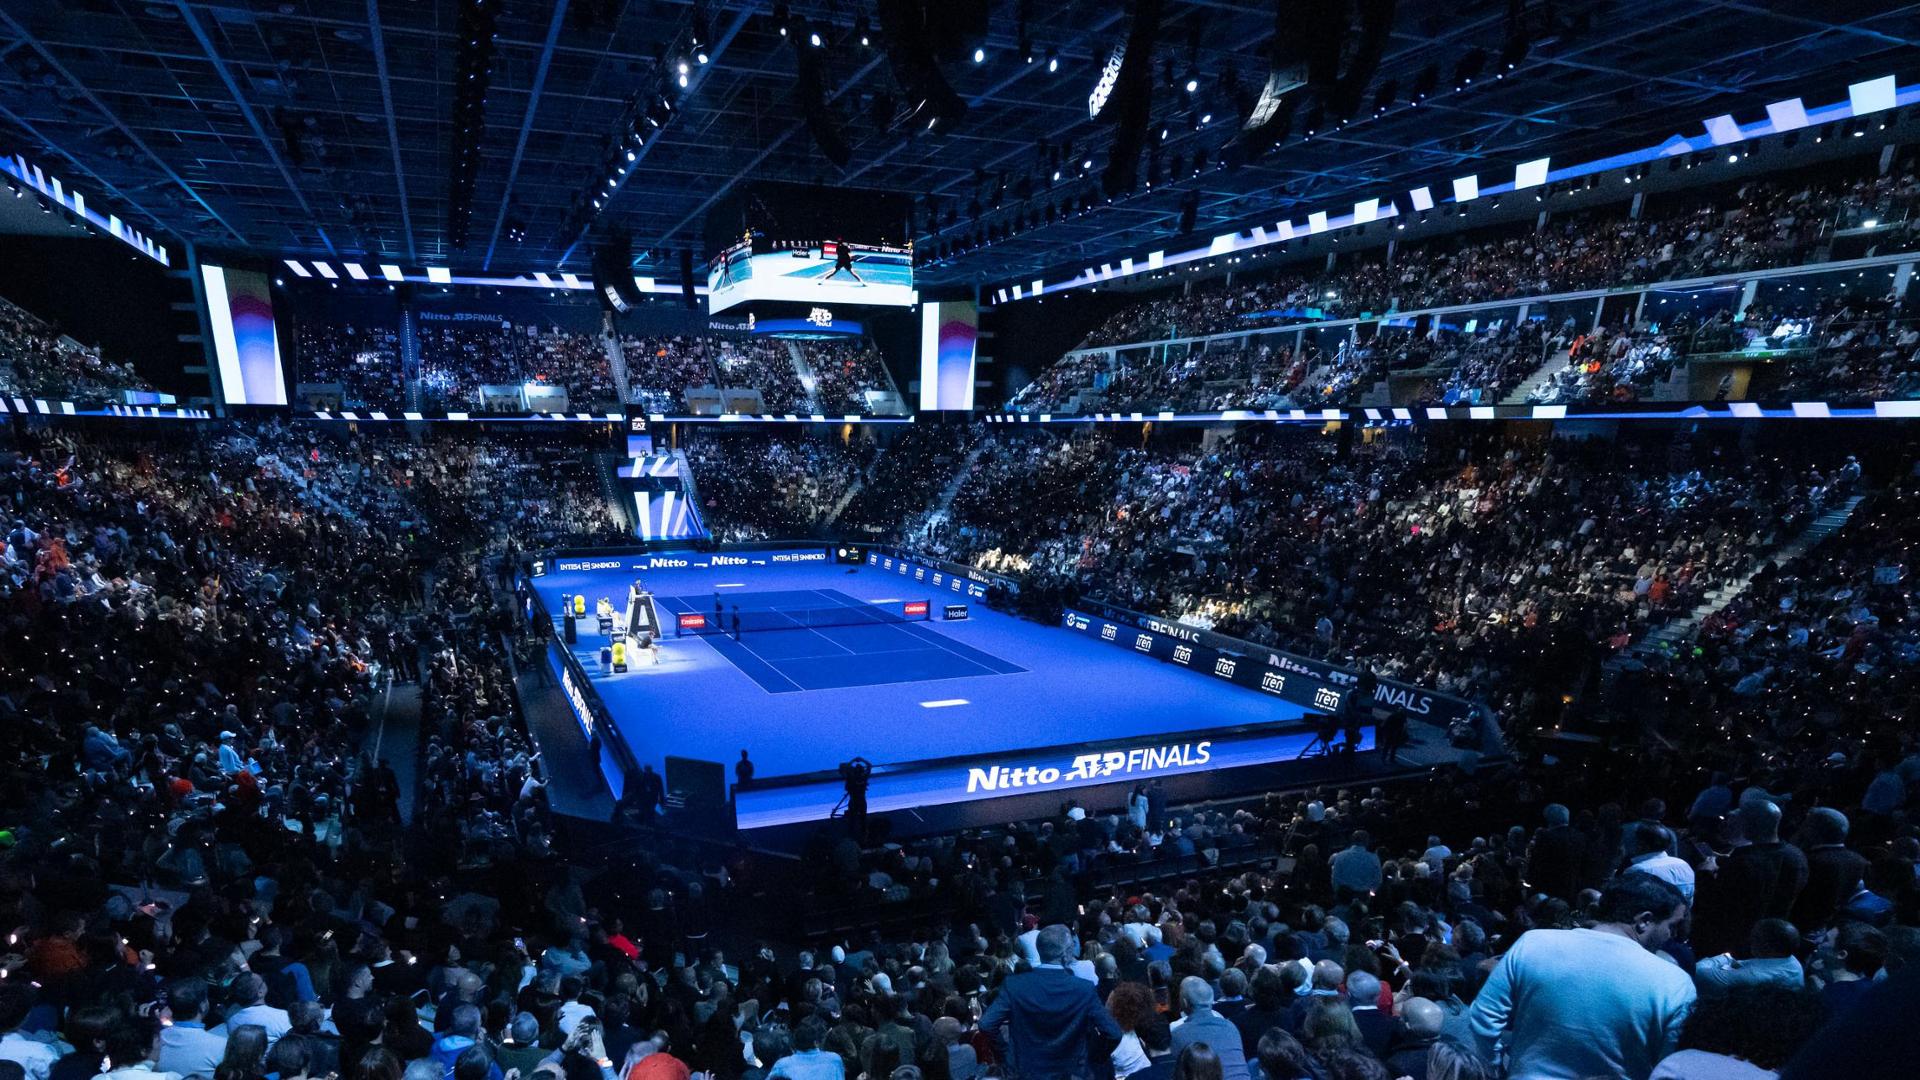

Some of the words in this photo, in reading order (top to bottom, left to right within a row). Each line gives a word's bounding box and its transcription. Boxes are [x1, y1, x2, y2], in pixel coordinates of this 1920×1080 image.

[420, 311, 450, 320] Nitto
[473, 314, 503, 322] FINALS
[709, 322, 735, 330] Nitto
[632, 422, 646, 430] EA7
[650, 558, 688, 568] Nitto
[711, 556, 748, 566] Nitto
[948, 610, 967, 618] Haier
[1136, 636, 1152, 650] iren
[1174, 649, 1191, 662] iren
[1215, 661, 1235, 676] iren
[1262, 676, 1284, 690] iren
[1315, 692, 1339, 708] iren
[1373, 683, 1433, 714] INALS
[966, 766, 1060, 793] Nitto
[1063, 752, 1126, 781] ATP
[1126, 741, 1211, 773] FINALS
